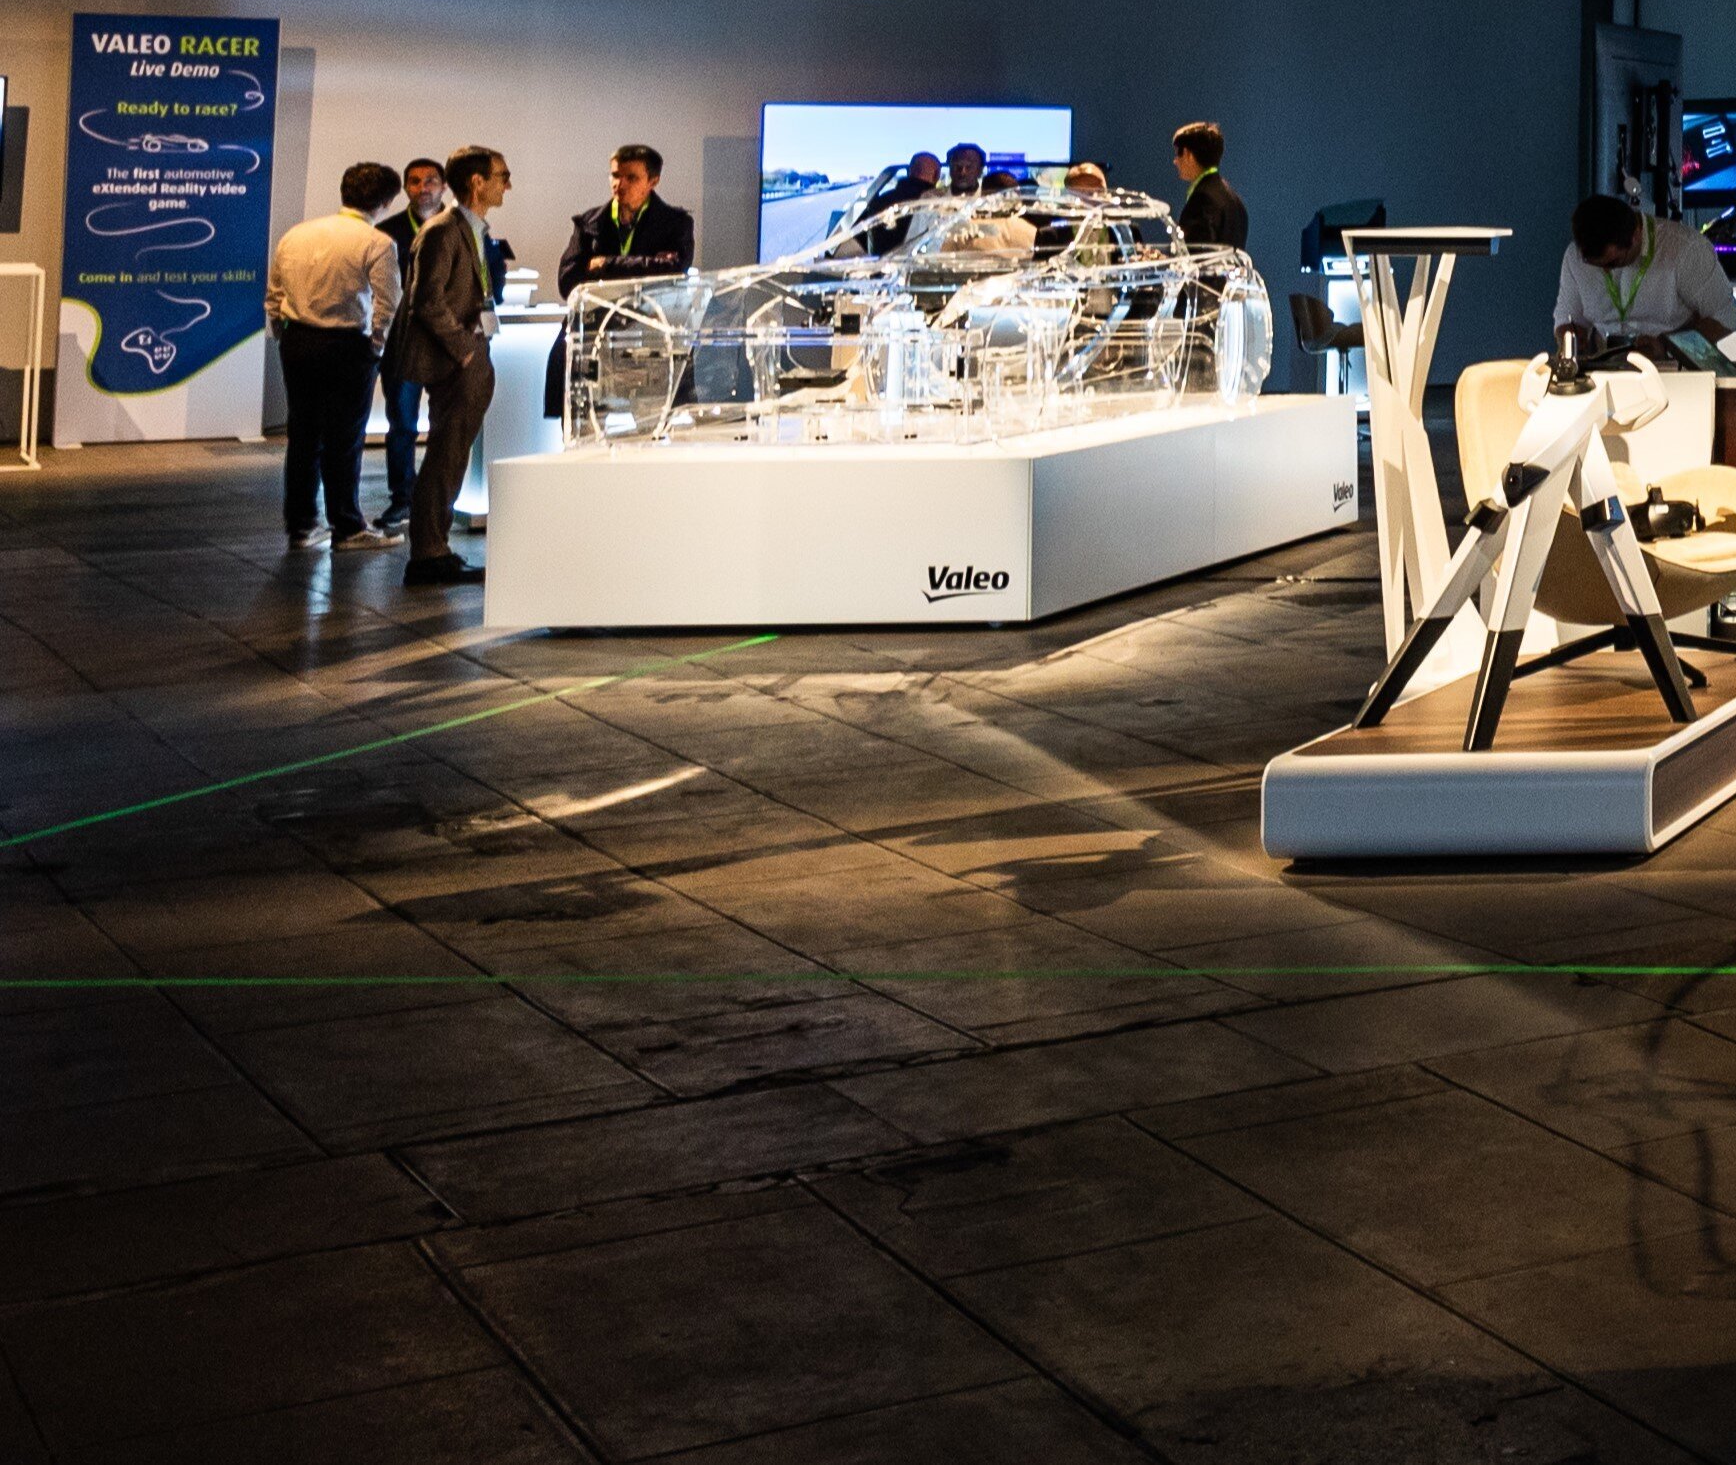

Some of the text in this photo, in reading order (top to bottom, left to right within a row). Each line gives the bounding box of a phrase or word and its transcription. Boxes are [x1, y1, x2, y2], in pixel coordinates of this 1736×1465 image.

[91, 33, 260, 57] VALEO RACER
[130, 59, 220, 78] Live Demo
[117, 101, 239, 118] Ready to race?
[107, 167, 235, 180] The first automotive
[92, 183, 247, 196] eXtended Reality video
[149, 198, 190, 211] game.
[78, 272, 116, 284] Come
[120, 272, 133, 283] in
[137, 271, 161, 283] and
[164, 271, 188, 282] test
[191, 271, 218, 284] your
[1333, 481, 1354, 502] Valeo
[927, 565, 1010, 591] Valeo
